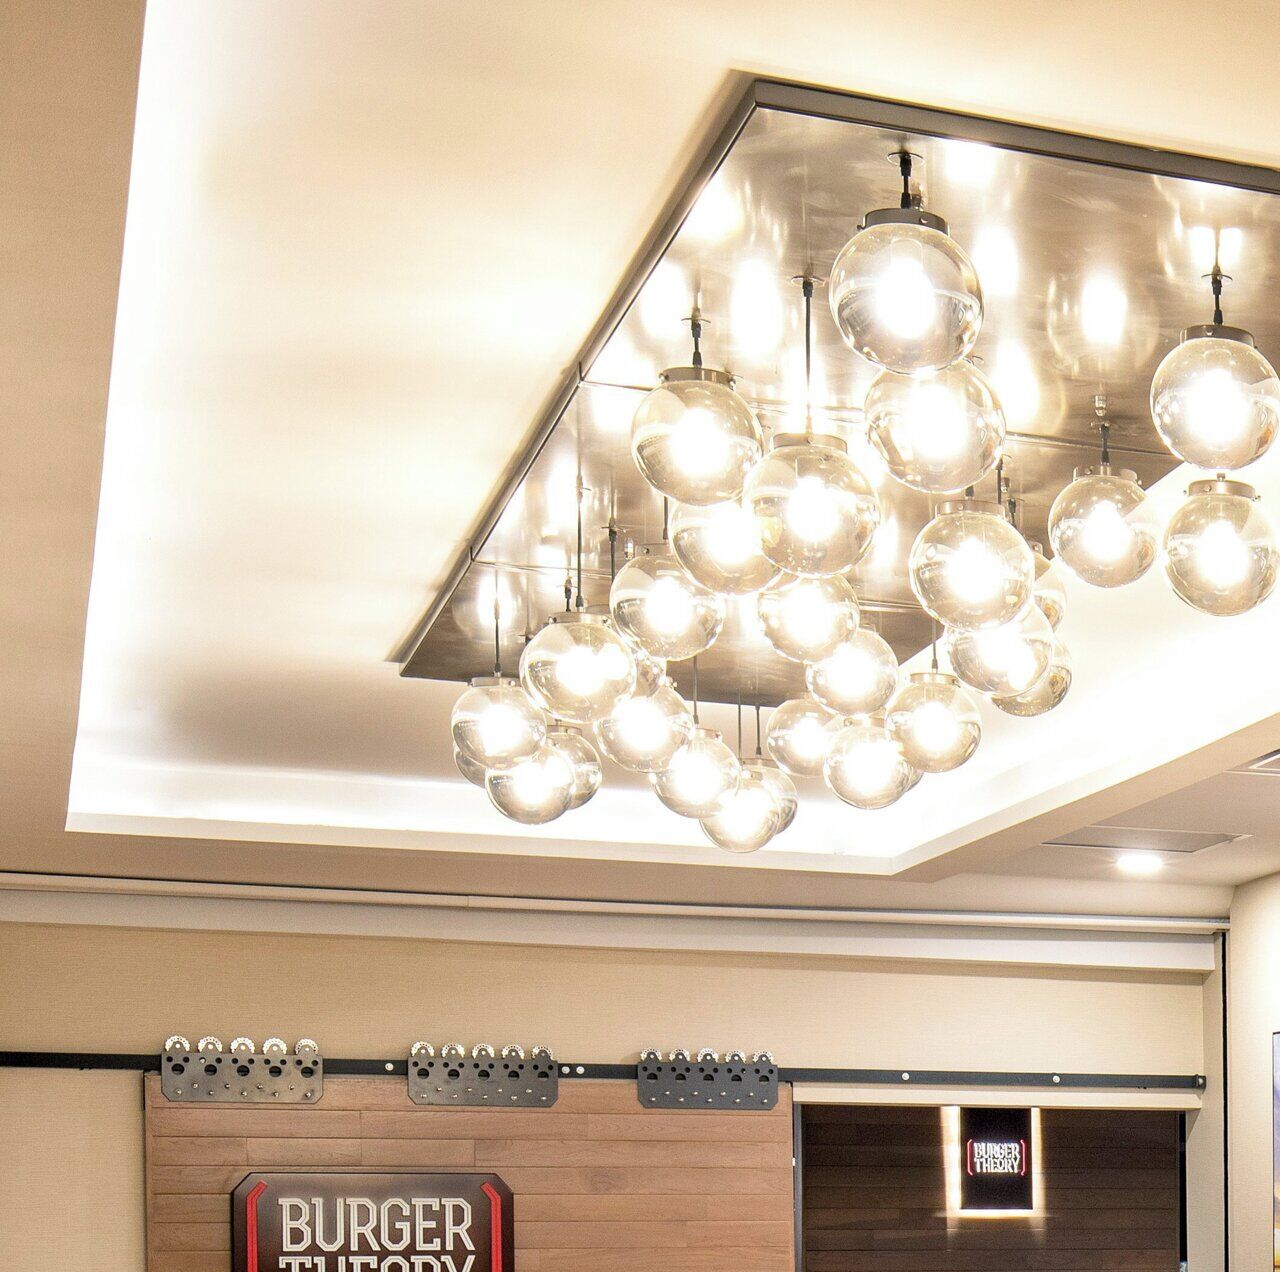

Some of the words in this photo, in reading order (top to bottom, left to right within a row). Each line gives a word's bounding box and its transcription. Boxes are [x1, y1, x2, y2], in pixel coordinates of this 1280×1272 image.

[973, 1142, 1021, 1159] BURGER
[973, 1157, 1021, 1173] THEORY
[278, 1197, 475, 1252] BURGER
